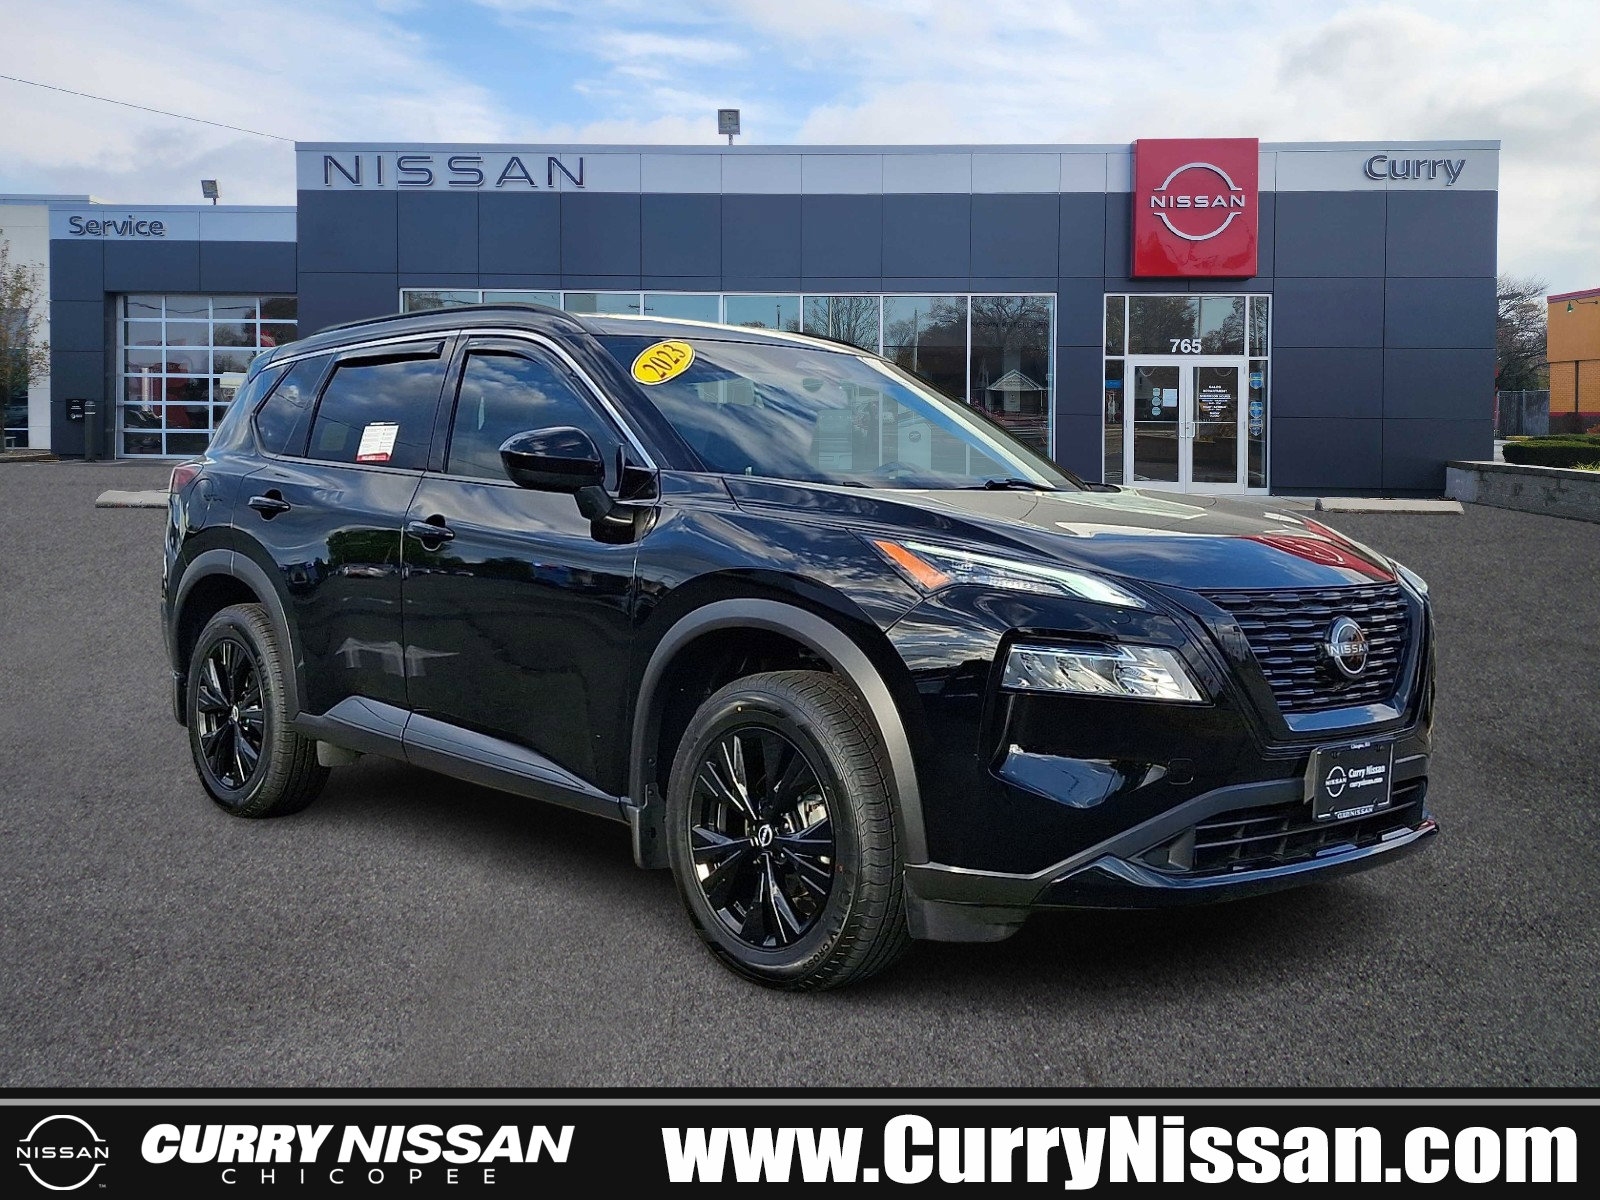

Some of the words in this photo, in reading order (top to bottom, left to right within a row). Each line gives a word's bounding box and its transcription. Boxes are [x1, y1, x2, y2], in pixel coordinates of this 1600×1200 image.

[323, 154, 586, 189] NISSAN
[1364, 154, 1466, 187] Curry
[1150, 194, 1246, 210] NISSAN
[68, 214, 166, 237] Service
[1169, 338, 1202, 354] 765
[642, 344, 686, 379] 2023
[1329, 643, 1369, 655] NISSAN
[1348, 768, 1366, 779] Curry
[1366, 764, 1386, 775] Nissan
[1325, 777, 1347, 786] NISSAN
